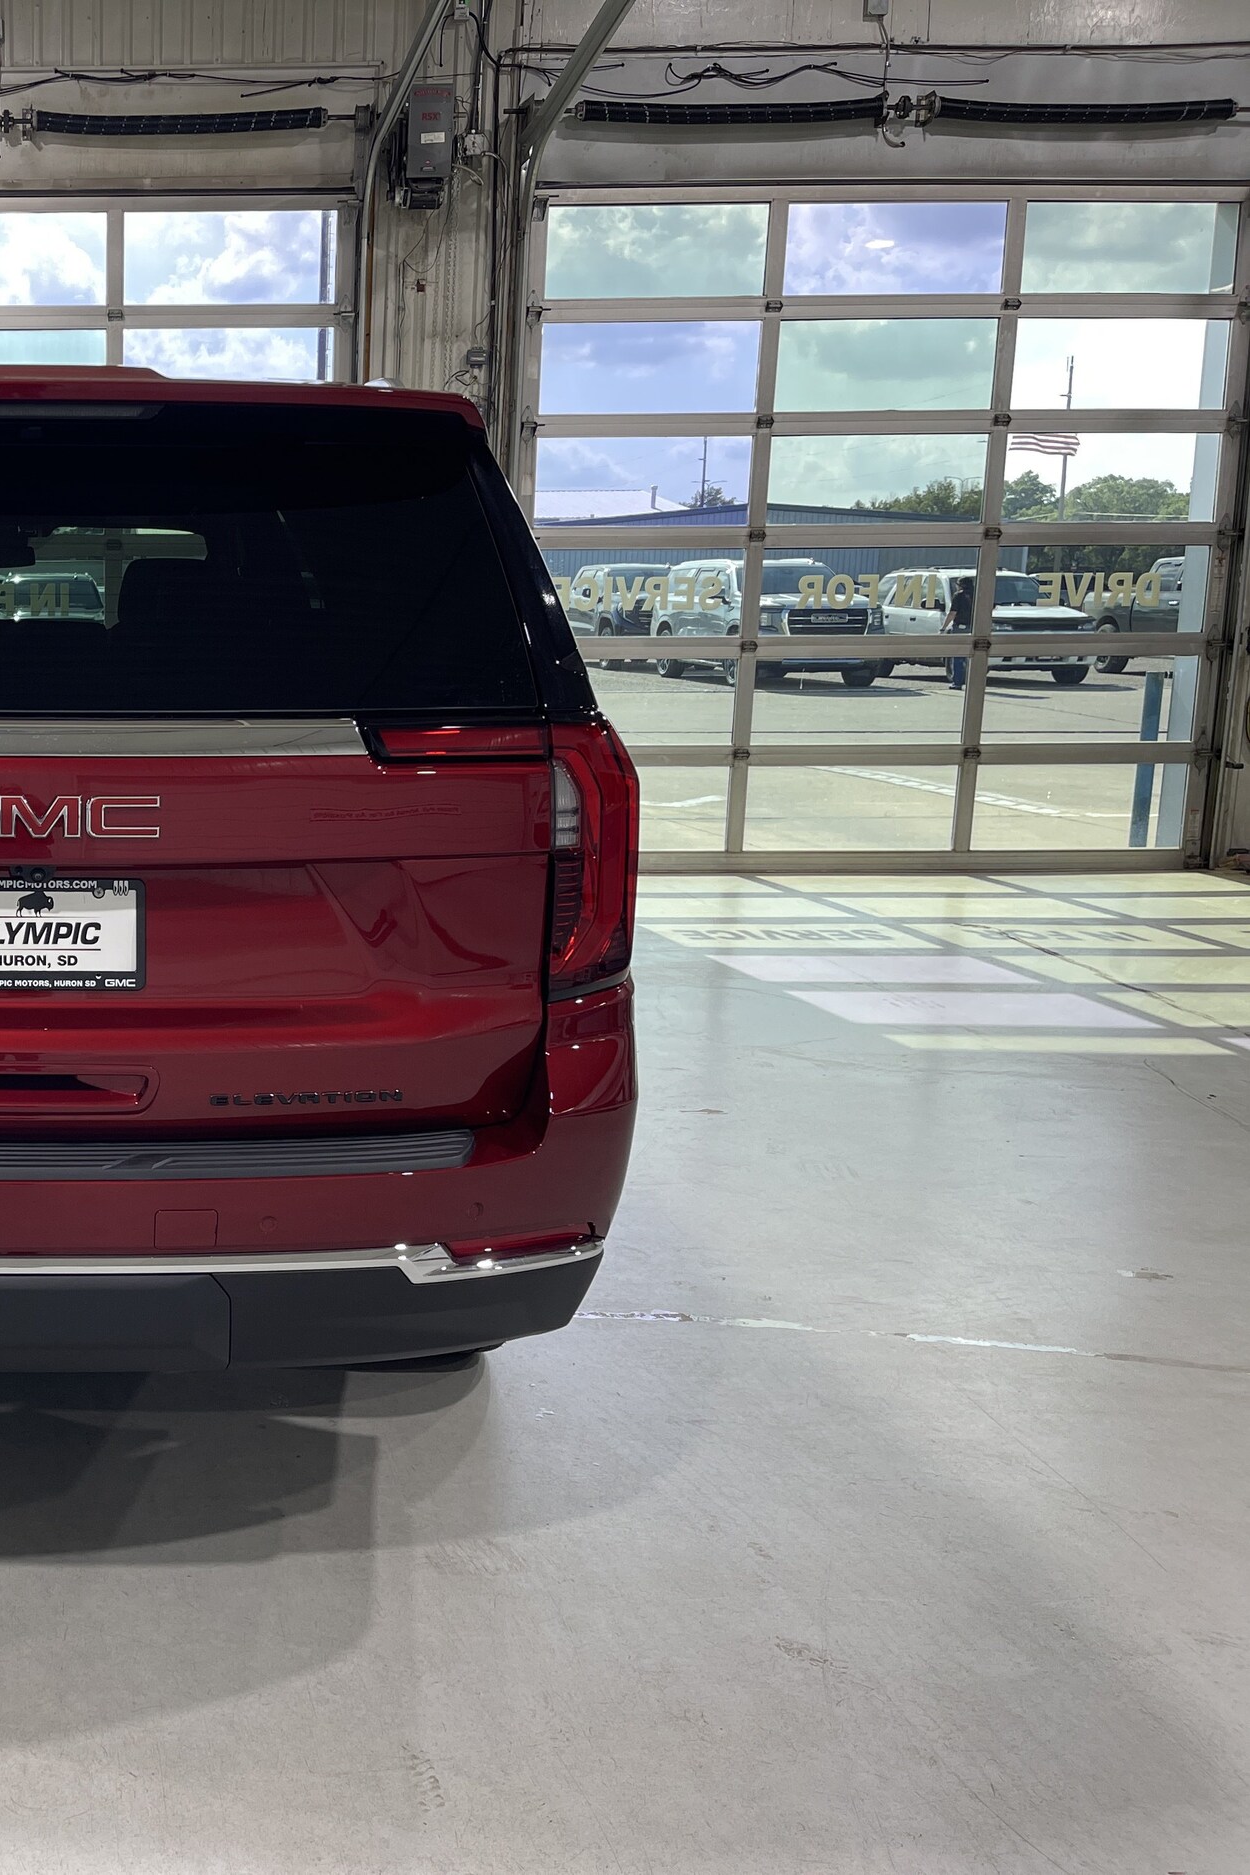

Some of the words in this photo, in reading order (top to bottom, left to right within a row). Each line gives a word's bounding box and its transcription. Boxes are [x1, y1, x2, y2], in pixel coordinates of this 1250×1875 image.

[57, 955, 78, 966] SD
[16, 979, 52, 988] MOTORS,
[54, 979, 83, 987] HURON
[104, 978, 136, 988] GMC
[209, 1089, 403, 1106] ELEVATION
